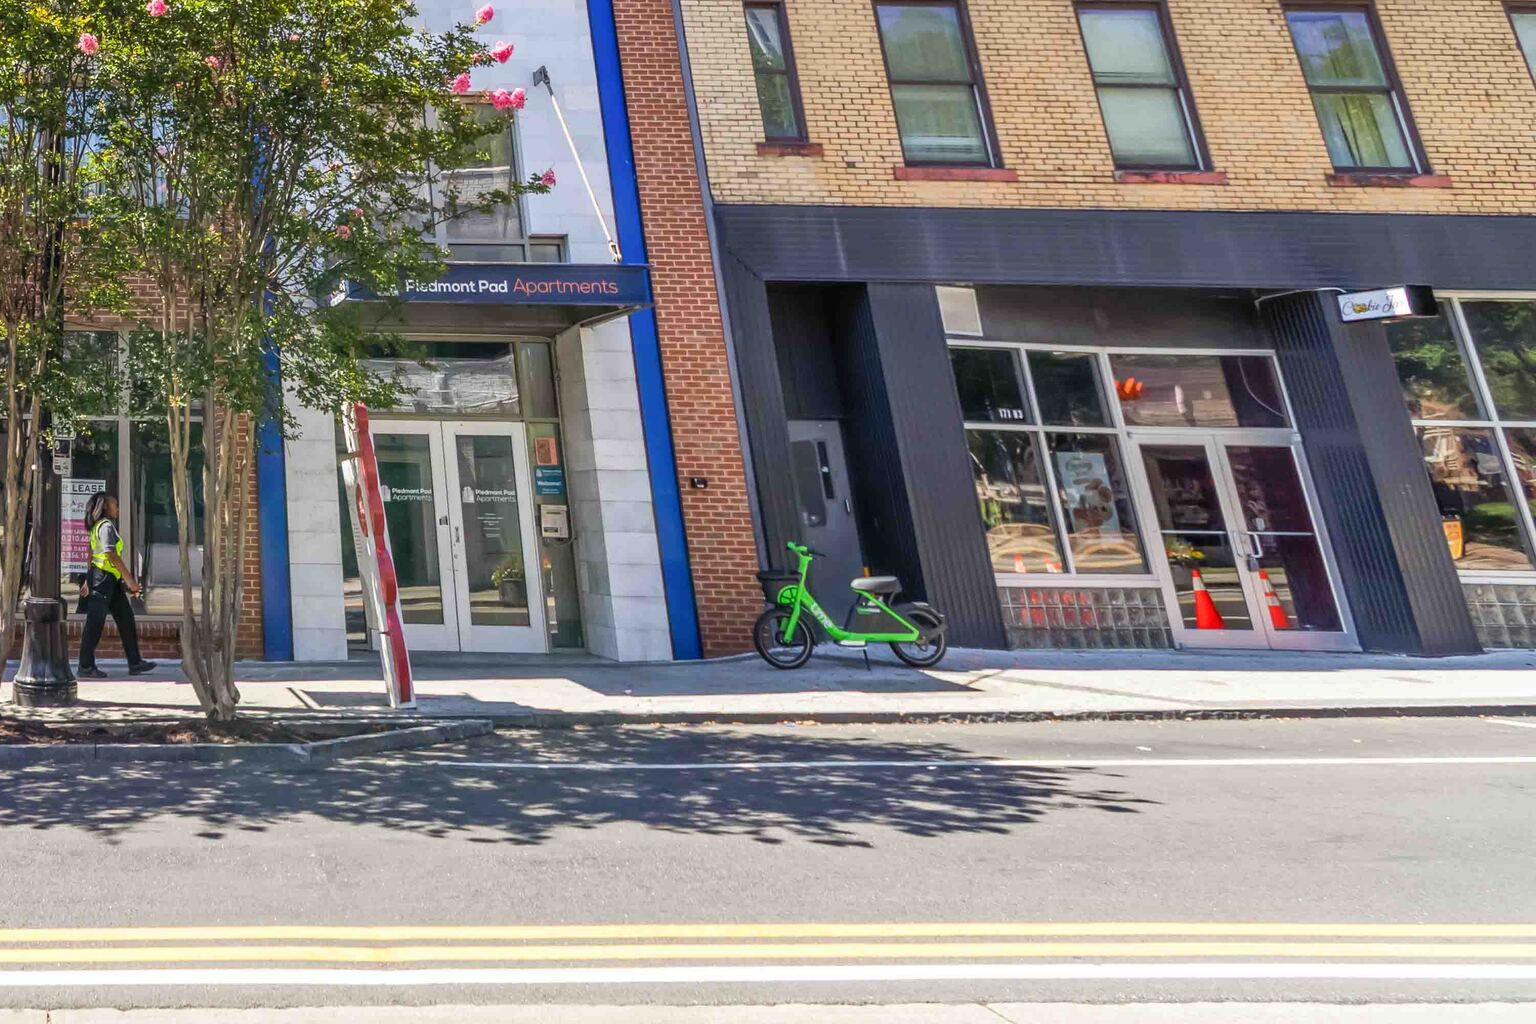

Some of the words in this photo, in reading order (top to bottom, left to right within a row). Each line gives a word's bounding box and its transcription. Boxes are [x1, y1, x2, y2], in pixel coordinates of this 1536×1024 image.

[406, 279, 475, 293] Piedmont
[479, 280, 507, 293] Pad
[513, 278, 618, 295] Apartments
[72, 484, 105, 493] LEASE
[393, 494, 433, 502] Apartments
